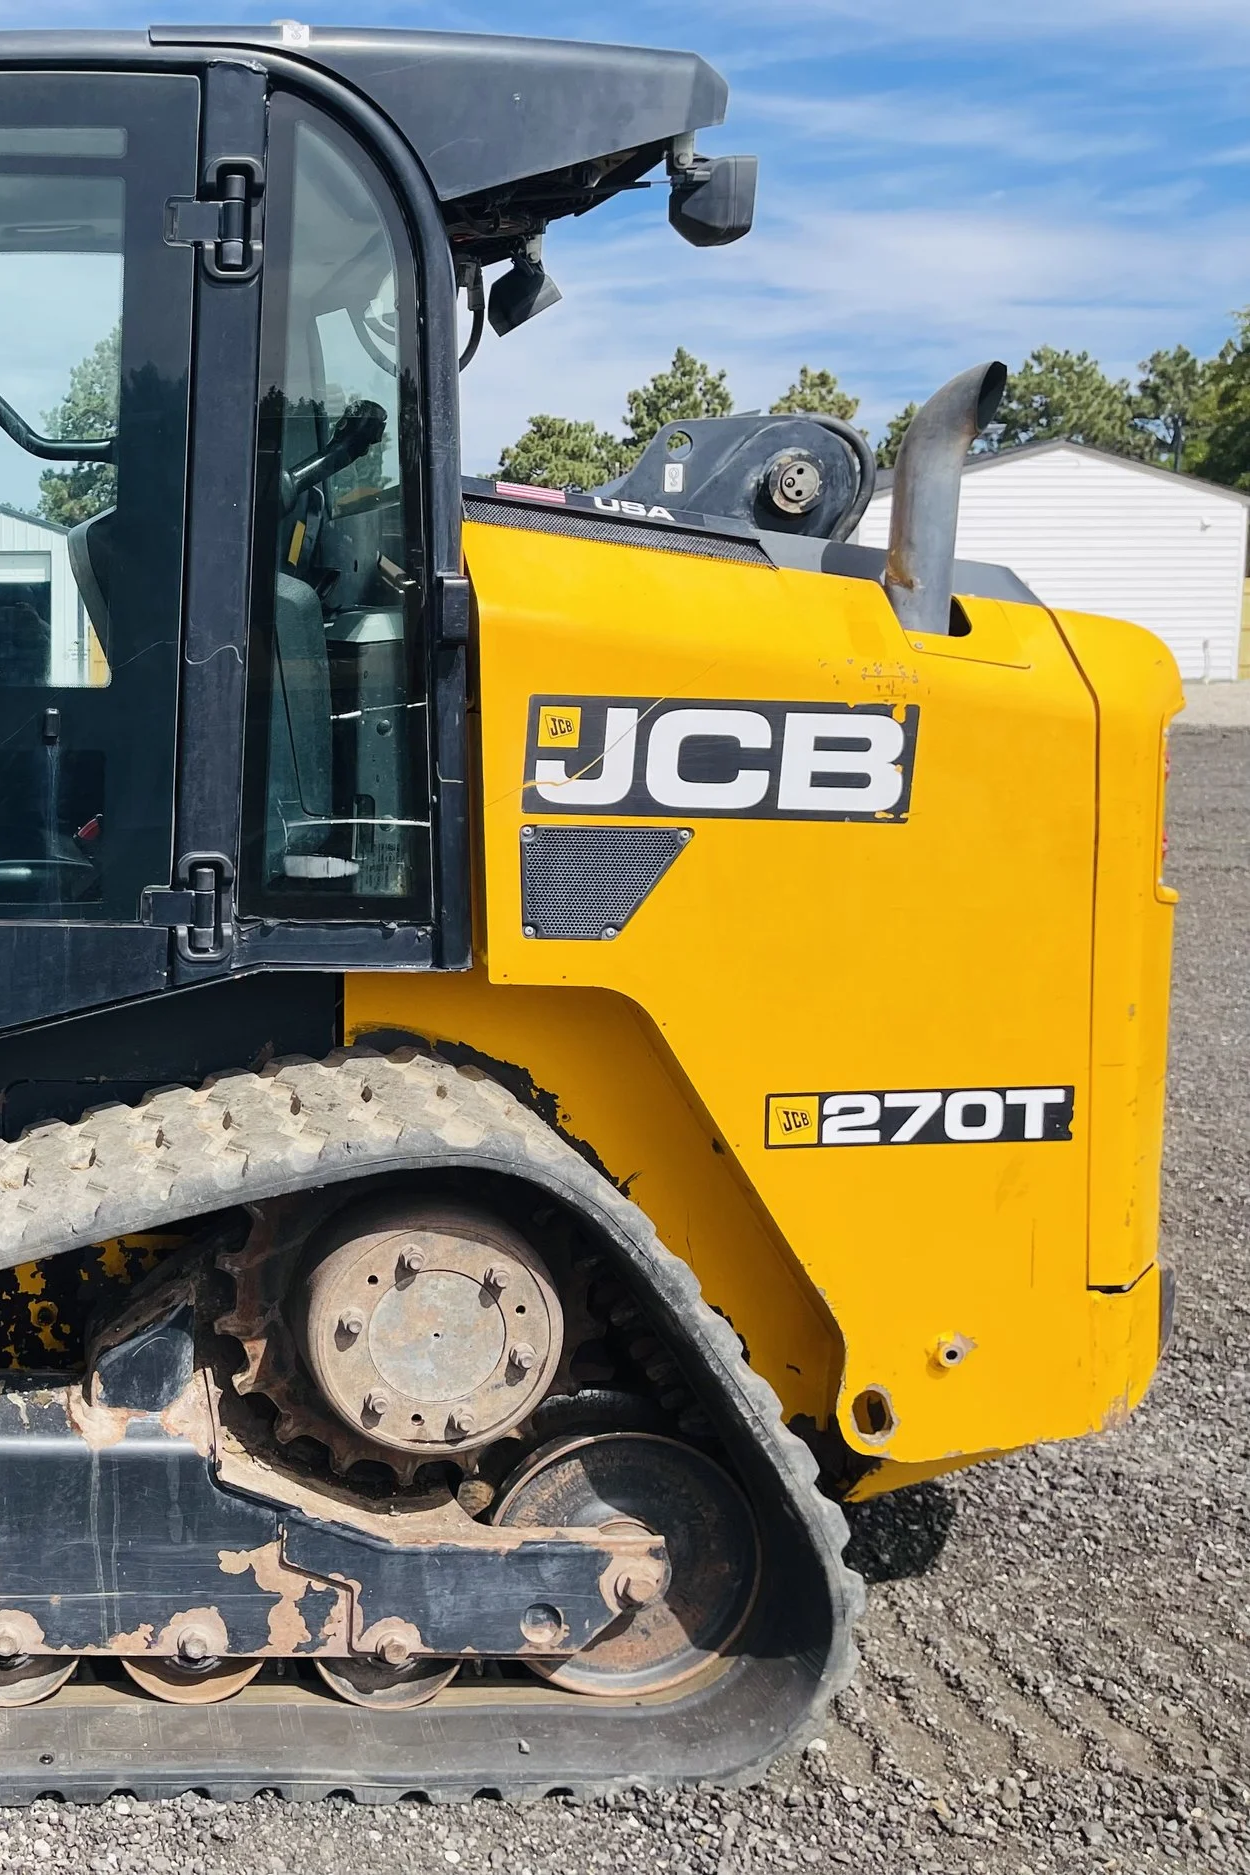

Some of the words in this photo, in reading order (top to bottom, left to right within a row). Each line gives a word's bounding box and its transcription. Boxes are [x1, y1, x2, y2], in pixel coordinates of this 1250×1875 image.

[594, 496, 675, 521] USA
[550, 717, 573, 736] JCB
[535, 707, 905, 812] JCB
[782, 1110, 810, 1132] JCB
[821, 1088, 1065, 1144] 270T
